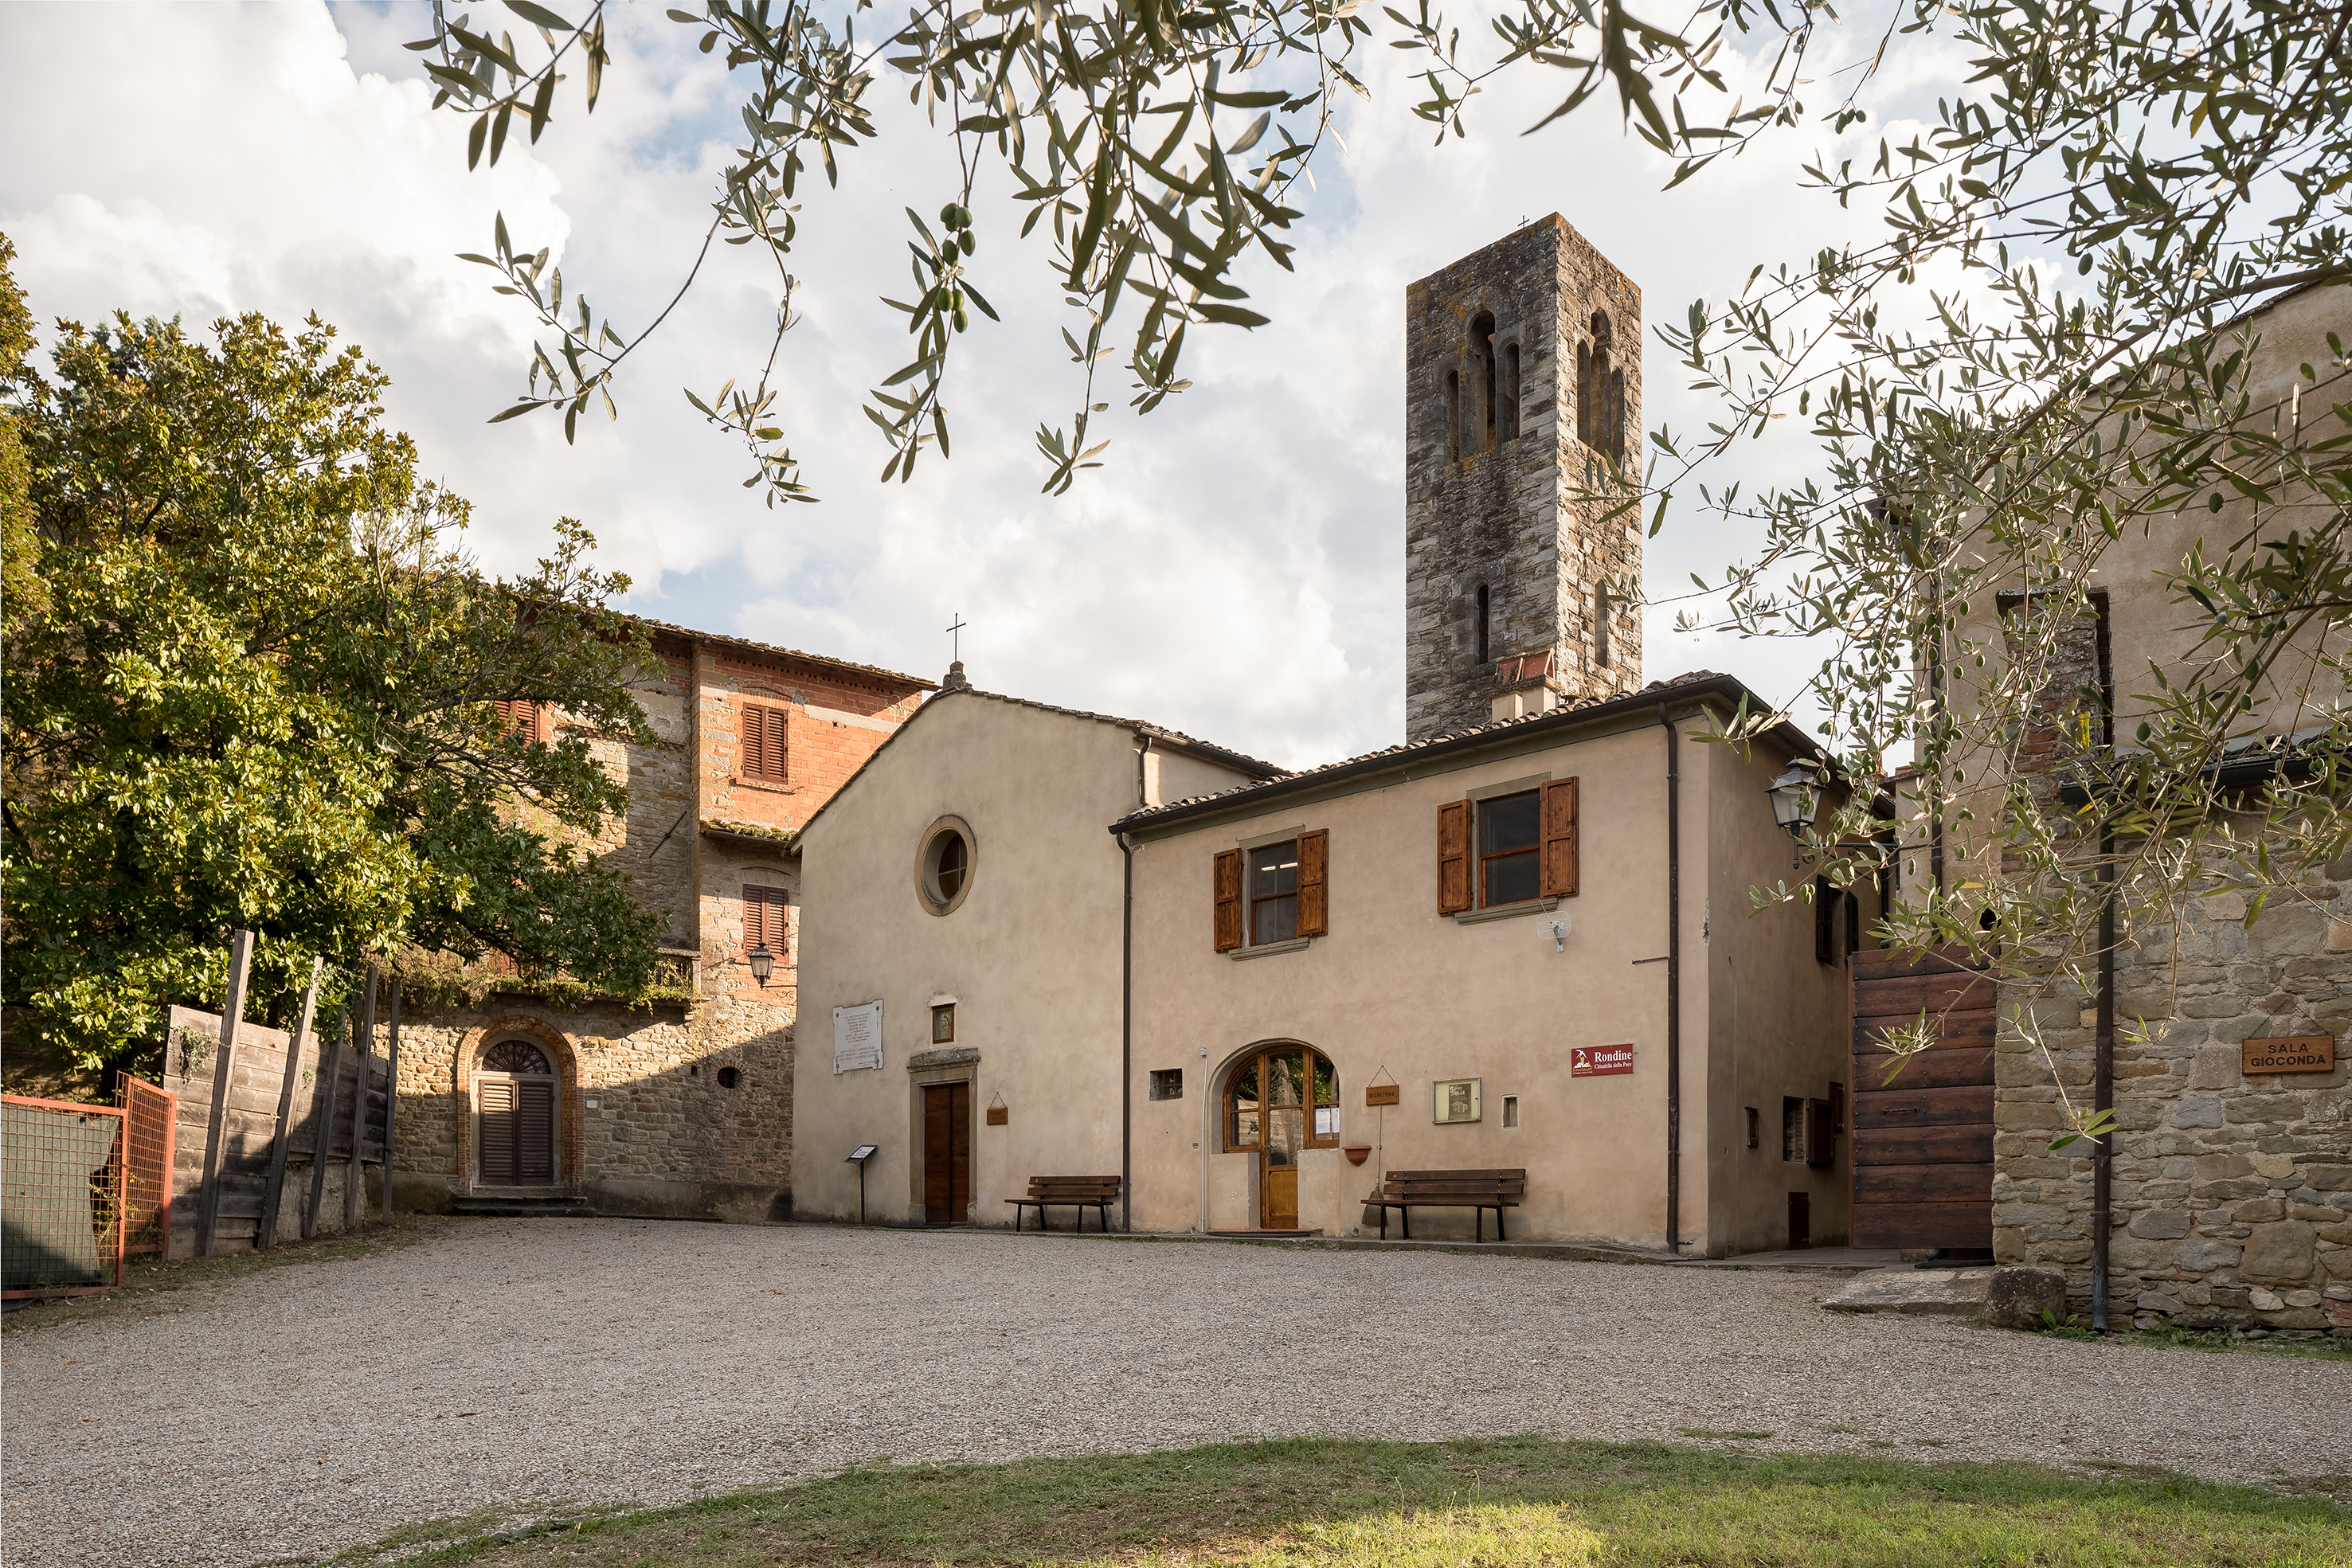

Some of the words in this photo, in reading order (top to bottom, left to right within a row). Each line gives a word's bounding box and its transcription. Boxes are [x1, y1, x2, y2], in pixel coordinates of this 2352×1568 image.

[2268, 1043, 2308, 1054] SALA
[1595, 1050, 1632, 1062] Rondine
[2251, 1054, 2326, 1067] GIOCONDA
